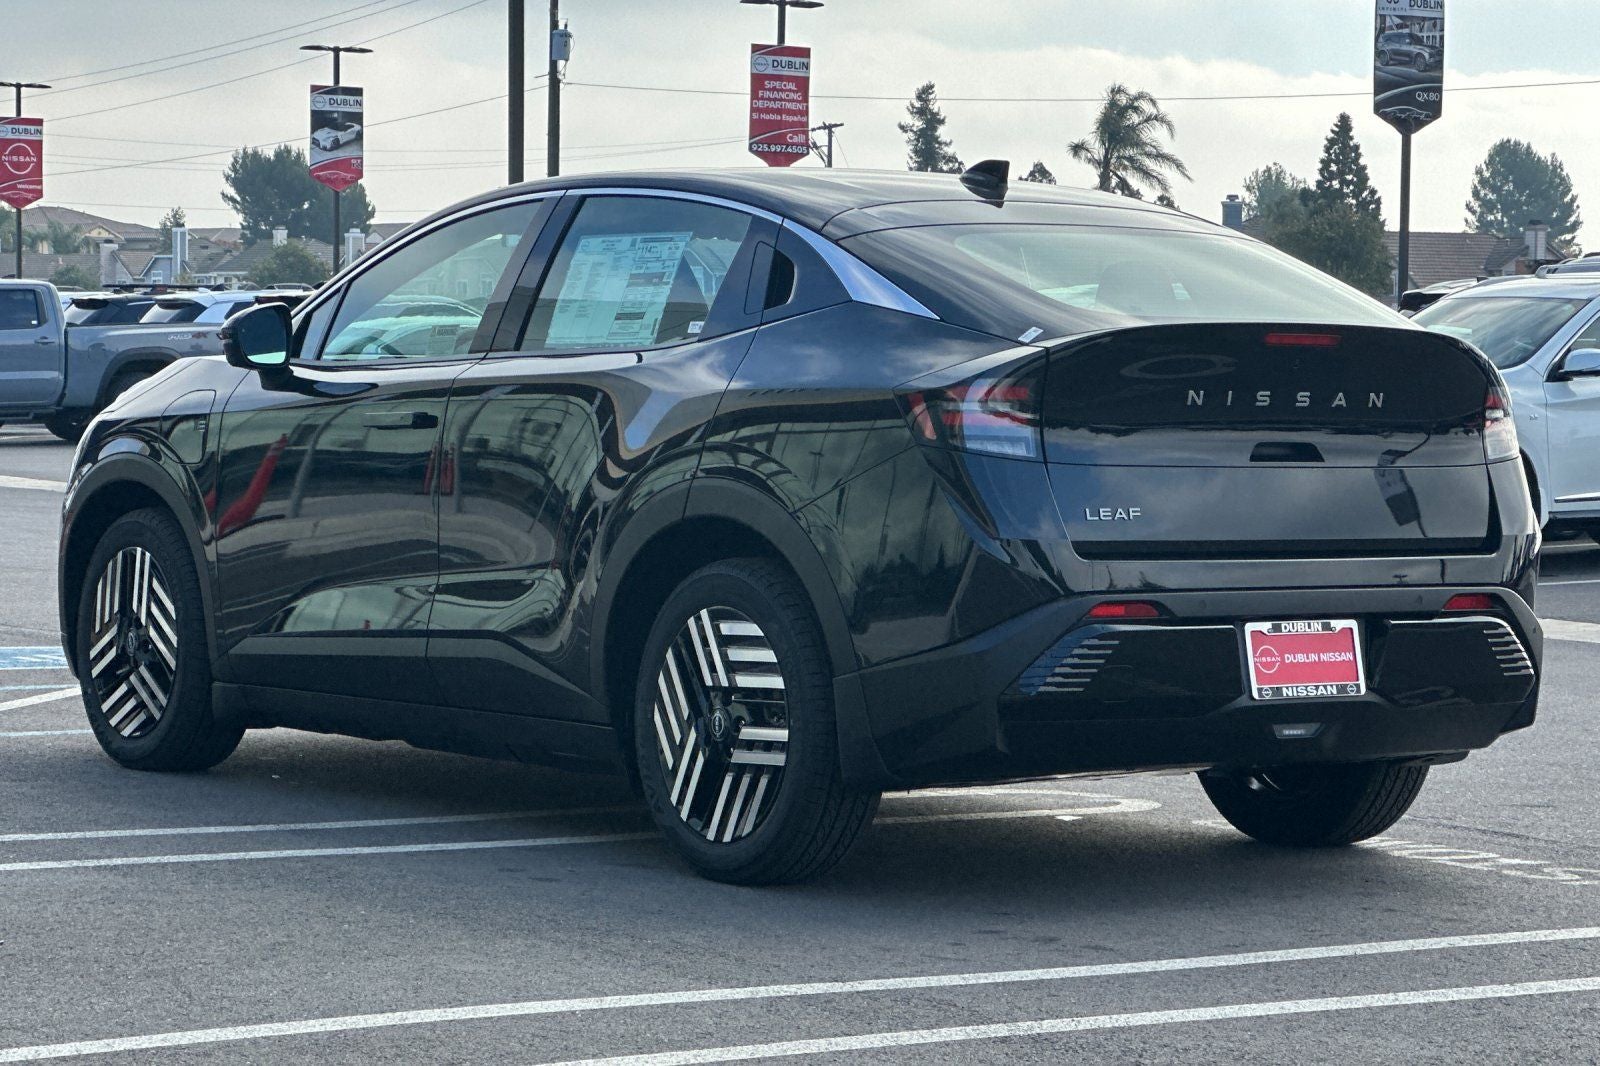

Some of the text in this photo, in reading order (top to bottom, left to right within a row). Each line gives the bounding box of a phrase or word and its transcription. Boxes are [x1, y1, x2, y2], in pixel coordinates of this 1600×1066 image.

[1409, 0, 1443, 10] DUBLIN
[771, 59, 809, 71] DUBLIN
[764, 80, 798, 90] SPECIAL
[758, 90, 802, 100] FINANCING
[1415, 91, 1440, 102] QX80
[328, 97, 362, 107] DUBLIN
[752, 99, 808, 110] DEPARTMENT
[760, 112, 781, 120] Habla
[10, 127, 42, 136] DUBLIN
[1186, 389, 1384, 408] NISSAN
[1085, 507, 1142, 520] LEAF
[1281, 621, 1322, 633] DUBLIN
[1284, 651, 1354, 664] DUBLIN NISSAN
[1282, 684, 1338, 697] NISSAN
